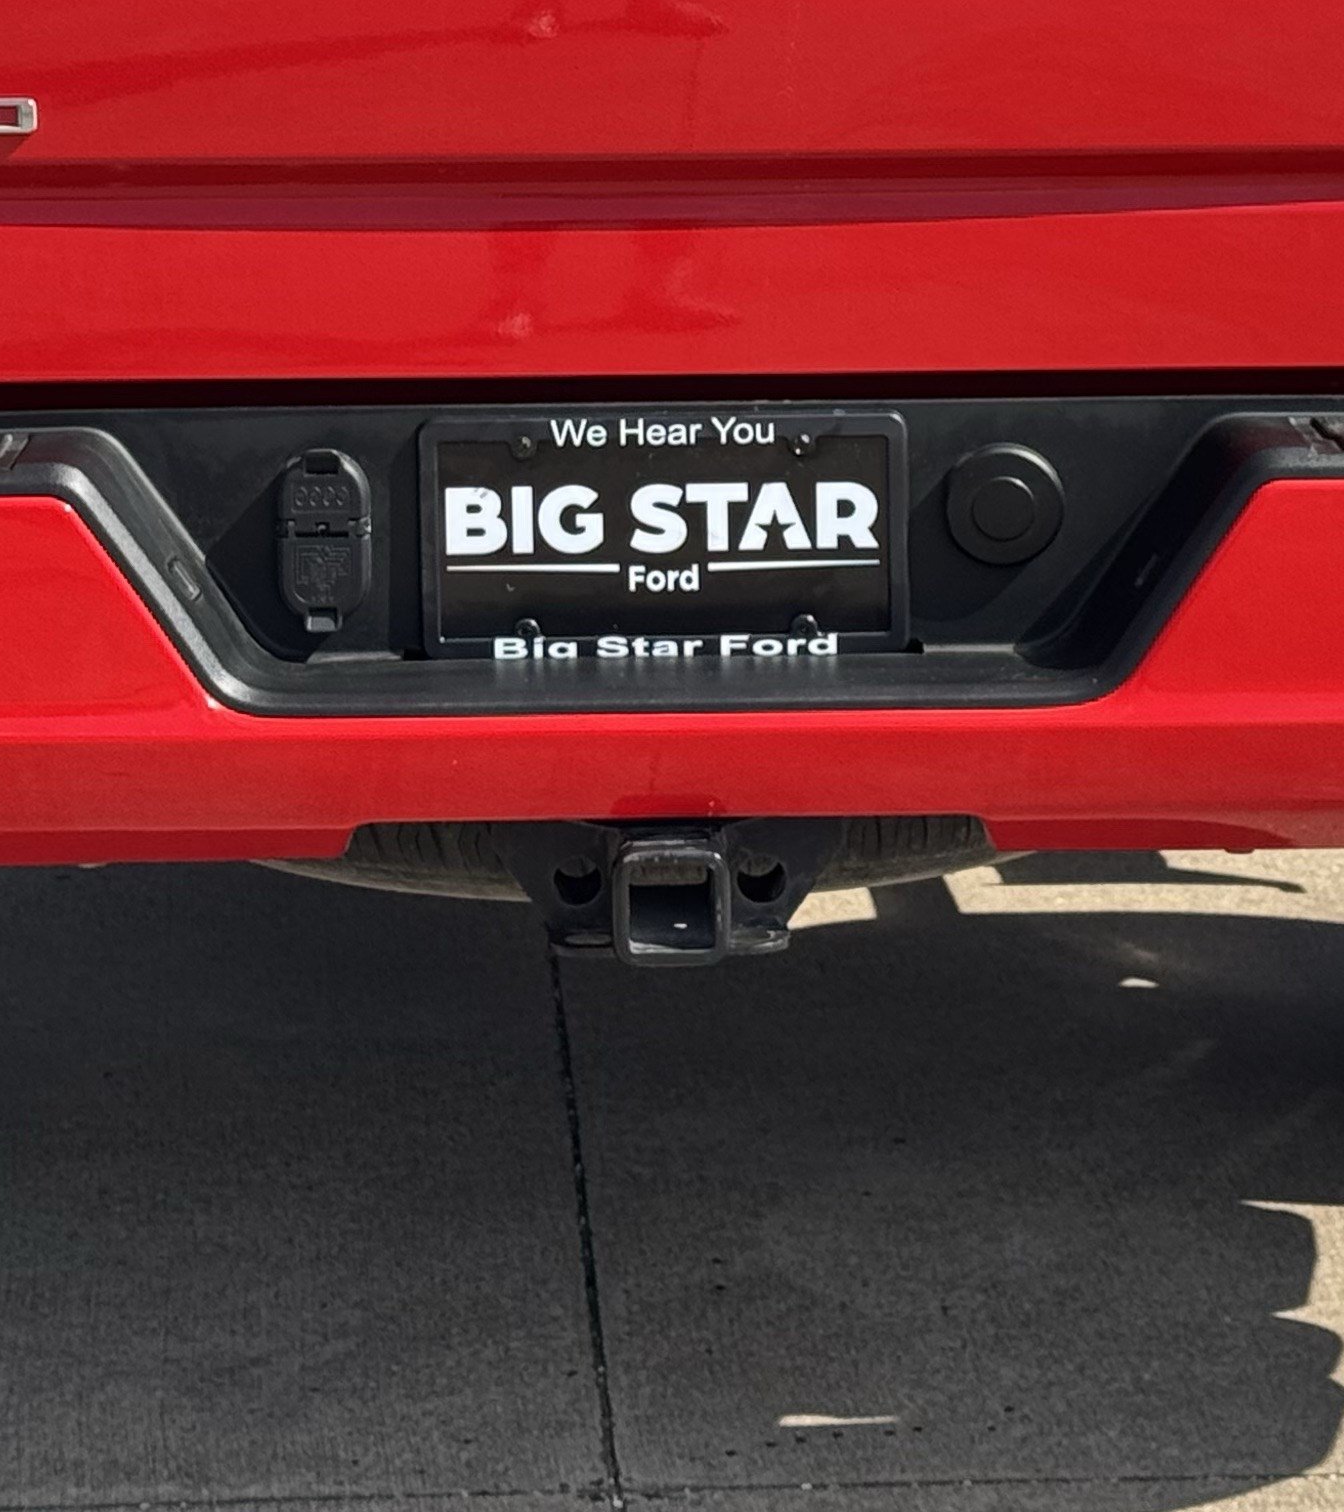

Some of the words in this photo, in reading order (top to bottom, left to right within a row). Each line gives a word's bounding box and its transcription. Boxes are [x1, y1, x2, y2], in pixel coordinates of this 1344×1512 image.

[550, 418, 608, 448] We
[619, 418, 703, 447] Hear
[710, 416, 775, 445] You
[443, 483, 605, 557] BIG
[628, 481, 881, 555] STAR
[627, 562, 701, 593] Ford
[492, 636, 579, 661] Big
[596, 635, 704, 660] Star
[719, 632, 840, 658] Ford
